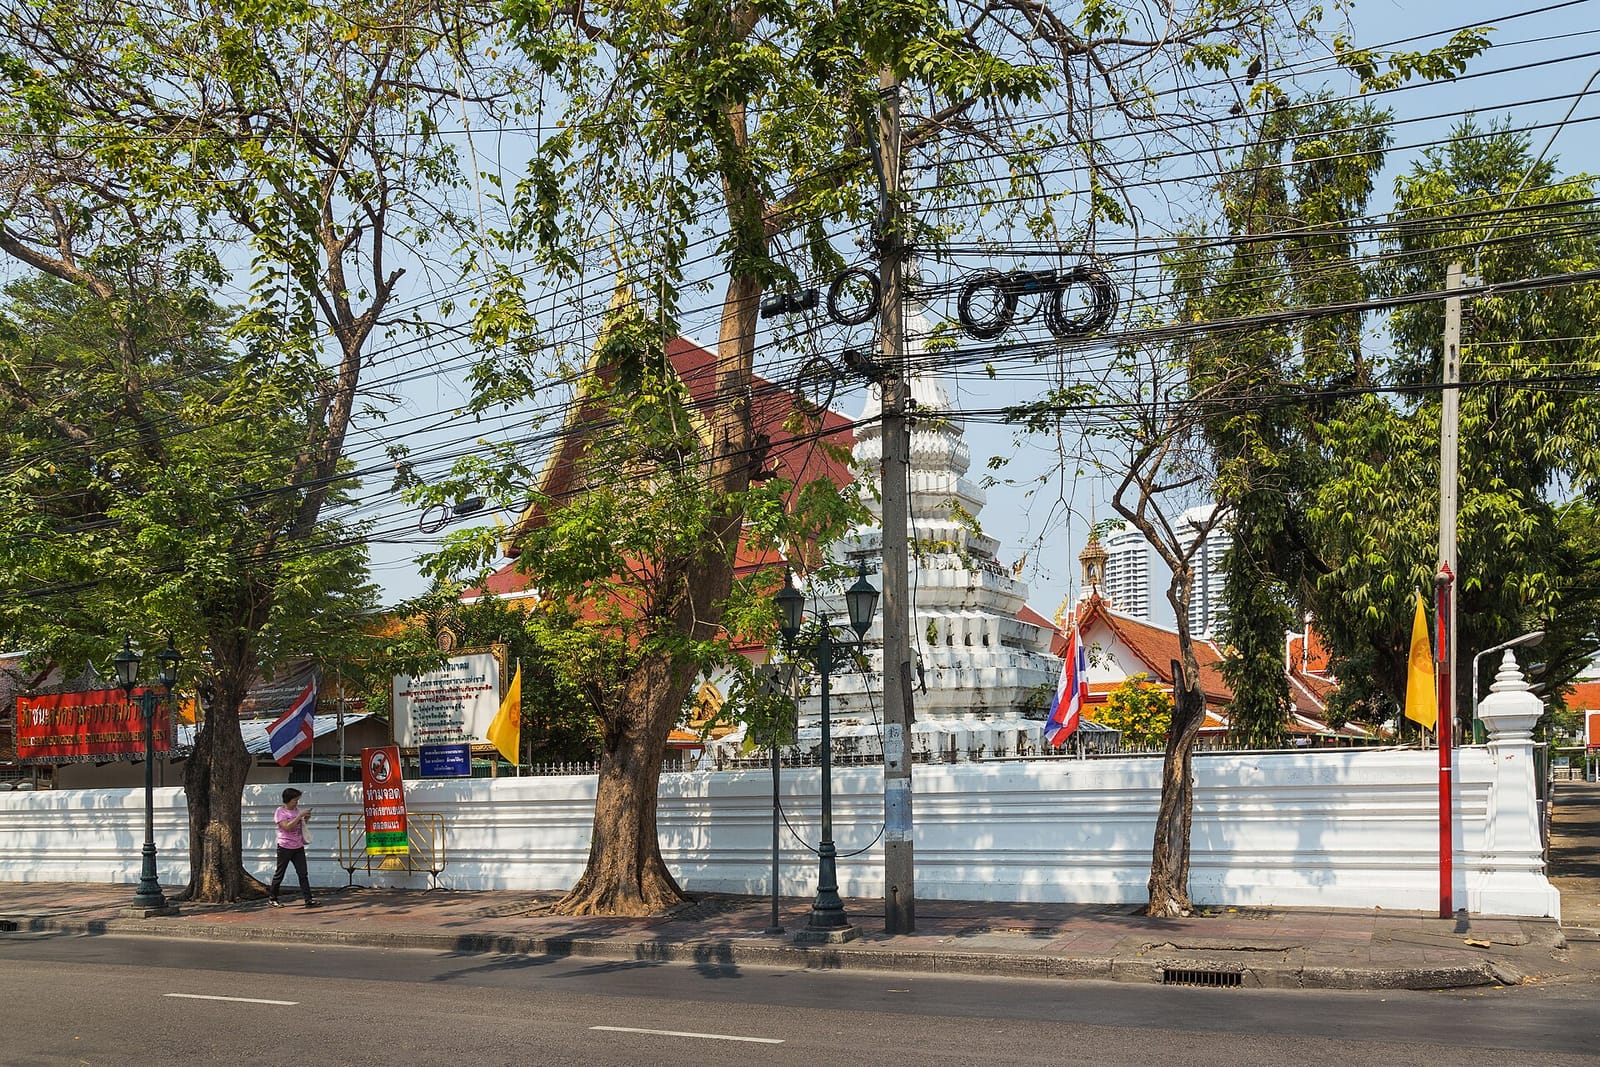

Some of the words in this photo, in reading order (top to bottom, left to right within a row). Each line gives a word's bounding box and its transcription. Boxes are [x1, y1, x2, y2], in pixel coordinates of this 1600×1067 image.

[367, 783, 401, 801] ห้ามจอด
[365, 802, 405, 817] รถจักรยานยนต์
